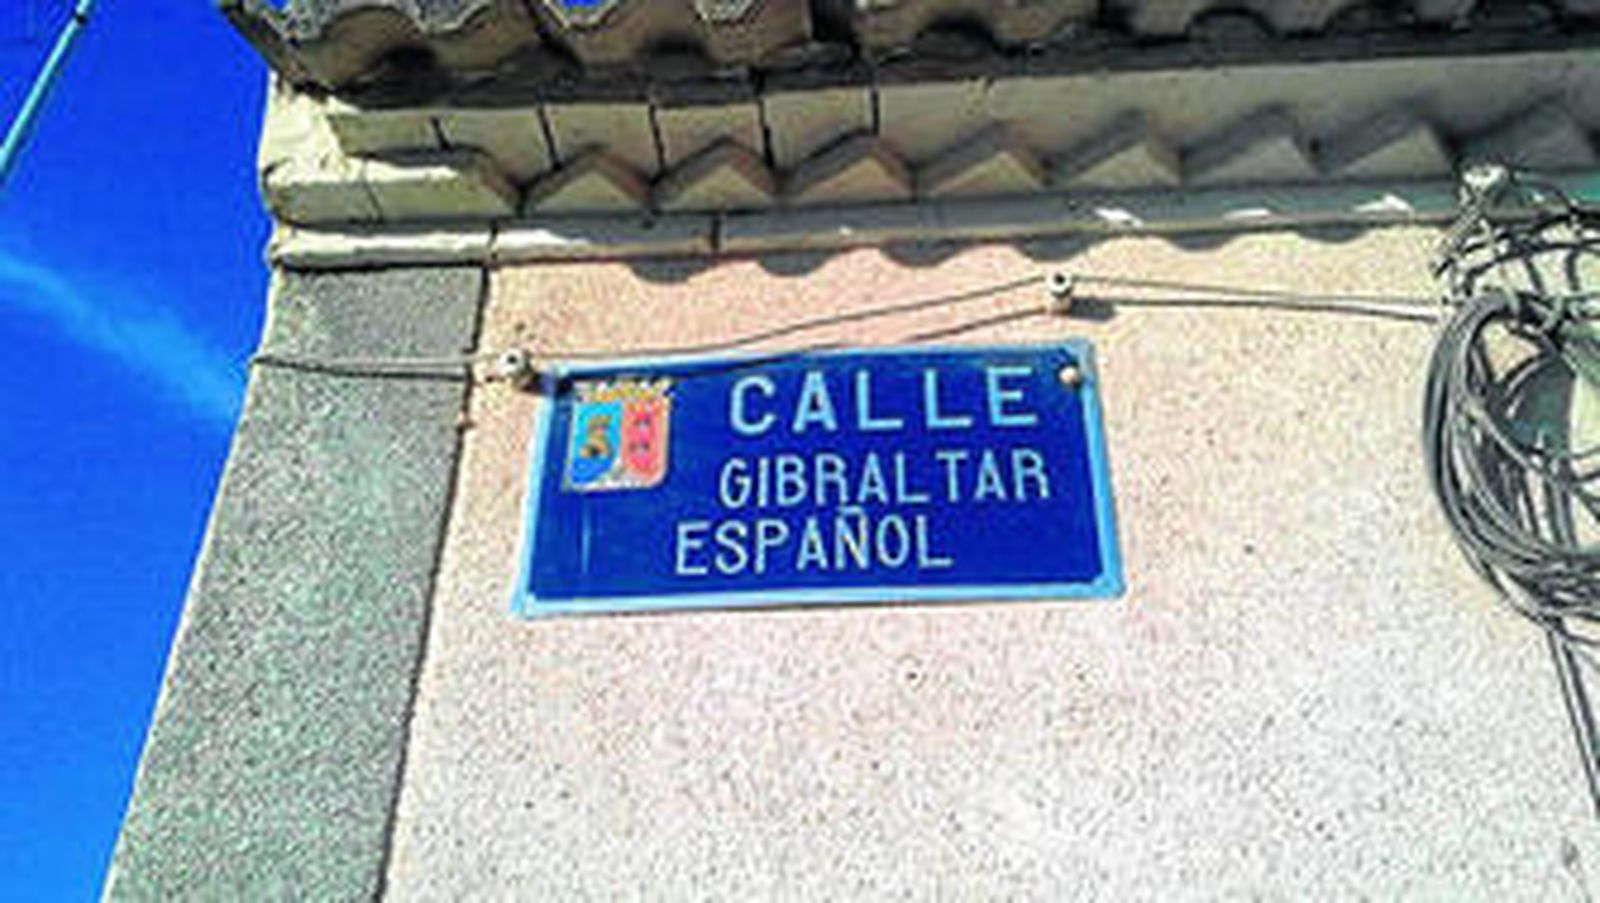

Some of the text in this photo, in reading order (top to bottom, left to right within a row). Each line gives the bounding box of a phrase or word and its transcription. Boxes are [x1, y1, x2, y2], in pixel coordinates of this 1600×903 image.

[730, 366, 1040, 434] CALLE
[719, 449, 1050, 508] GIBRALTAR
[675, 506, 954, 575] ESPAÑOL
